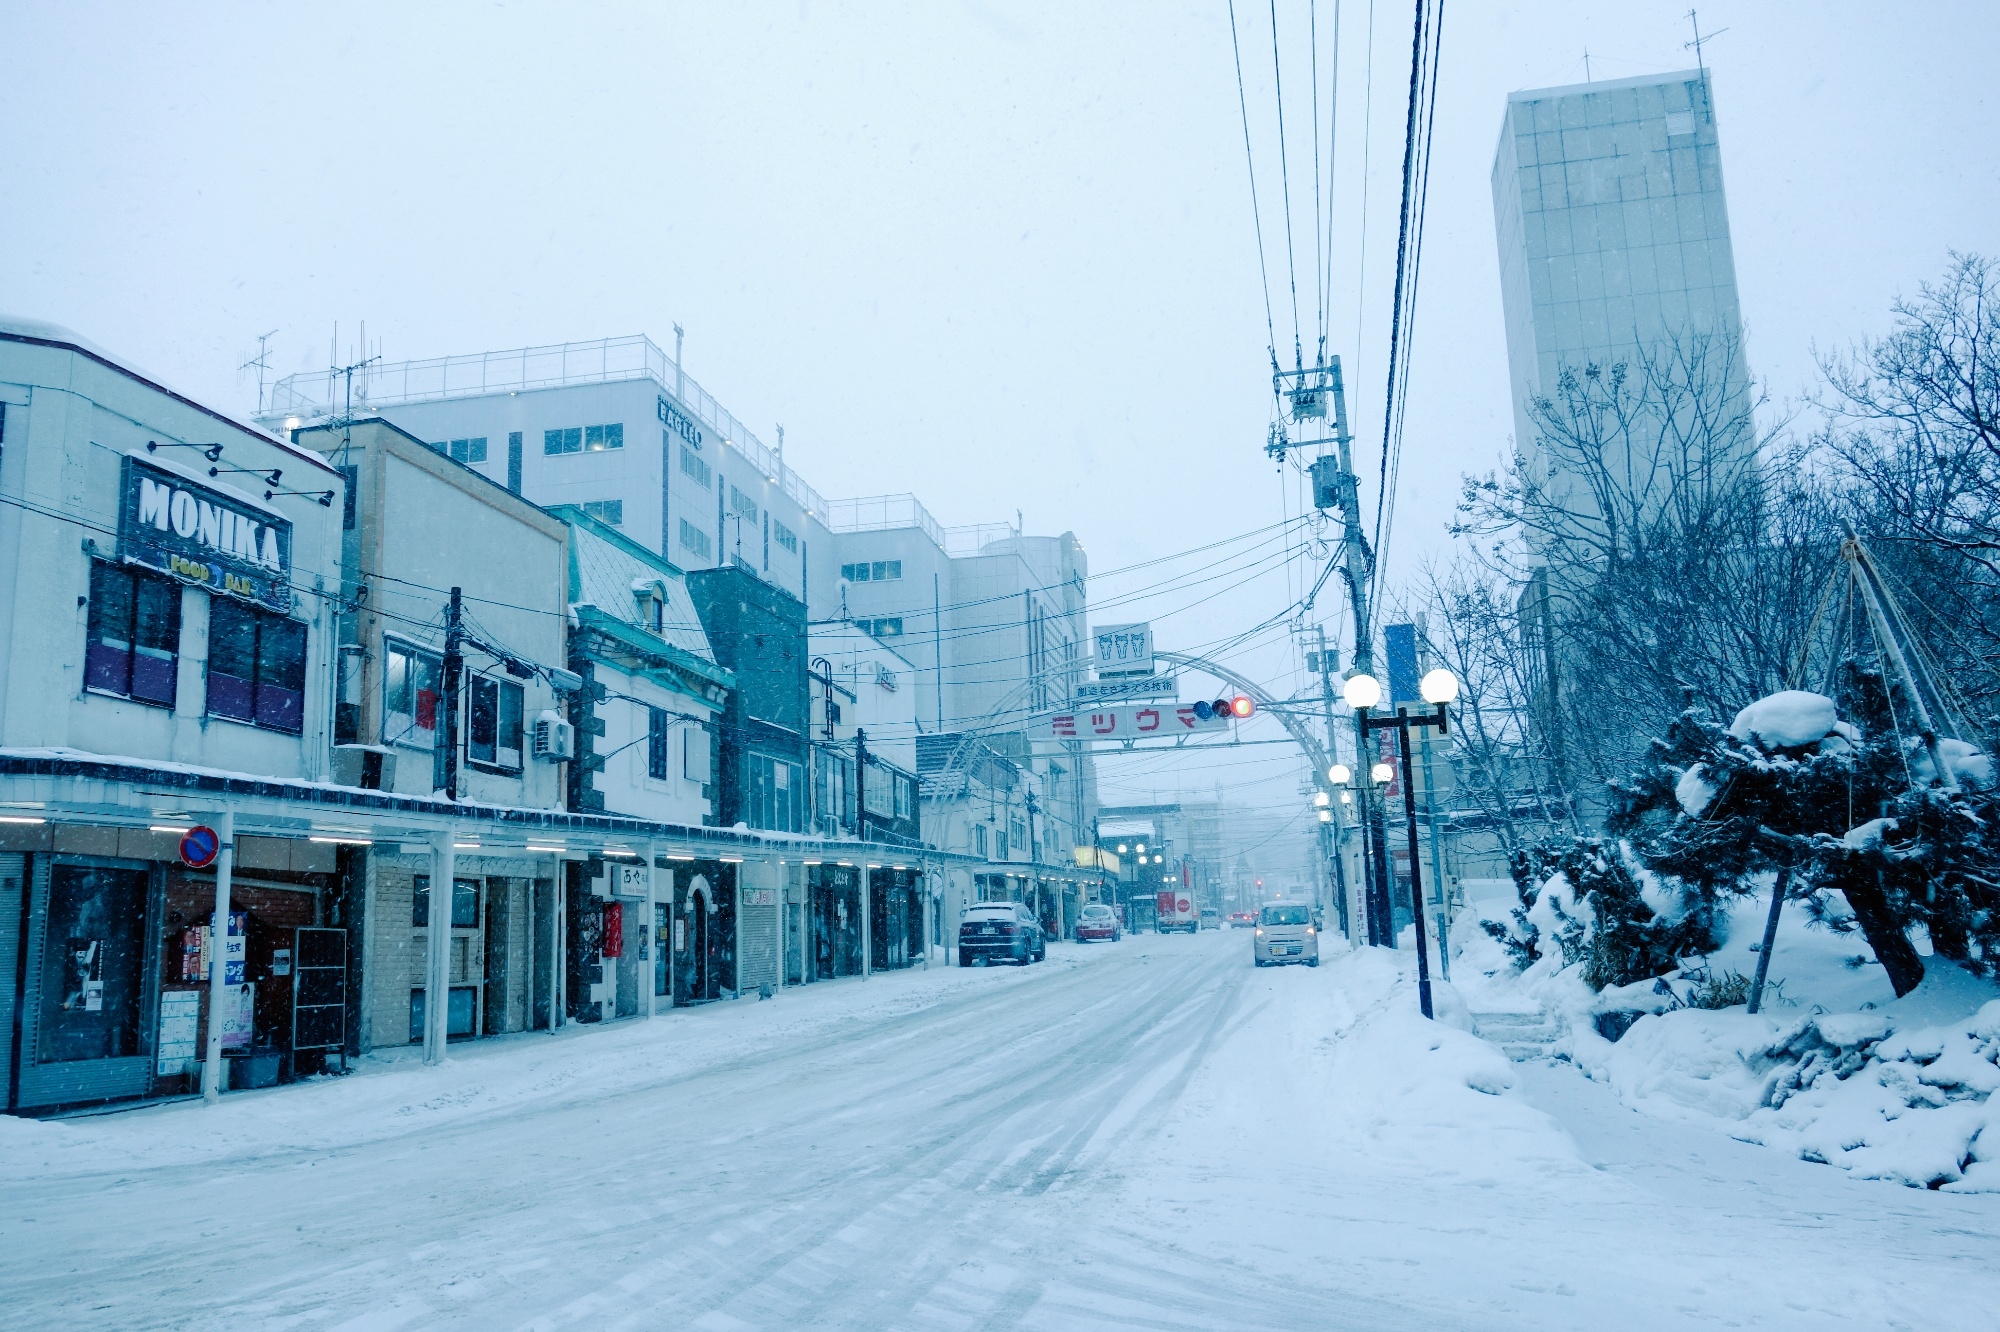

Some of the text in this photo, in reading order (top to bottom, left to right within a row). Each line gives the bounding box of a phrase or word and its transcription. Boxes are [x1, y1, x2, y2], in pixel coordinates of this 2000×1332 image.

[138, 477, 281, 572] MONIKA
[170, 553, 250, 595] FOOD BAR
[1077, 682, 1172, 698] 創造をささえる技術
[1052, 708, 1196, 736] ミツウマ
